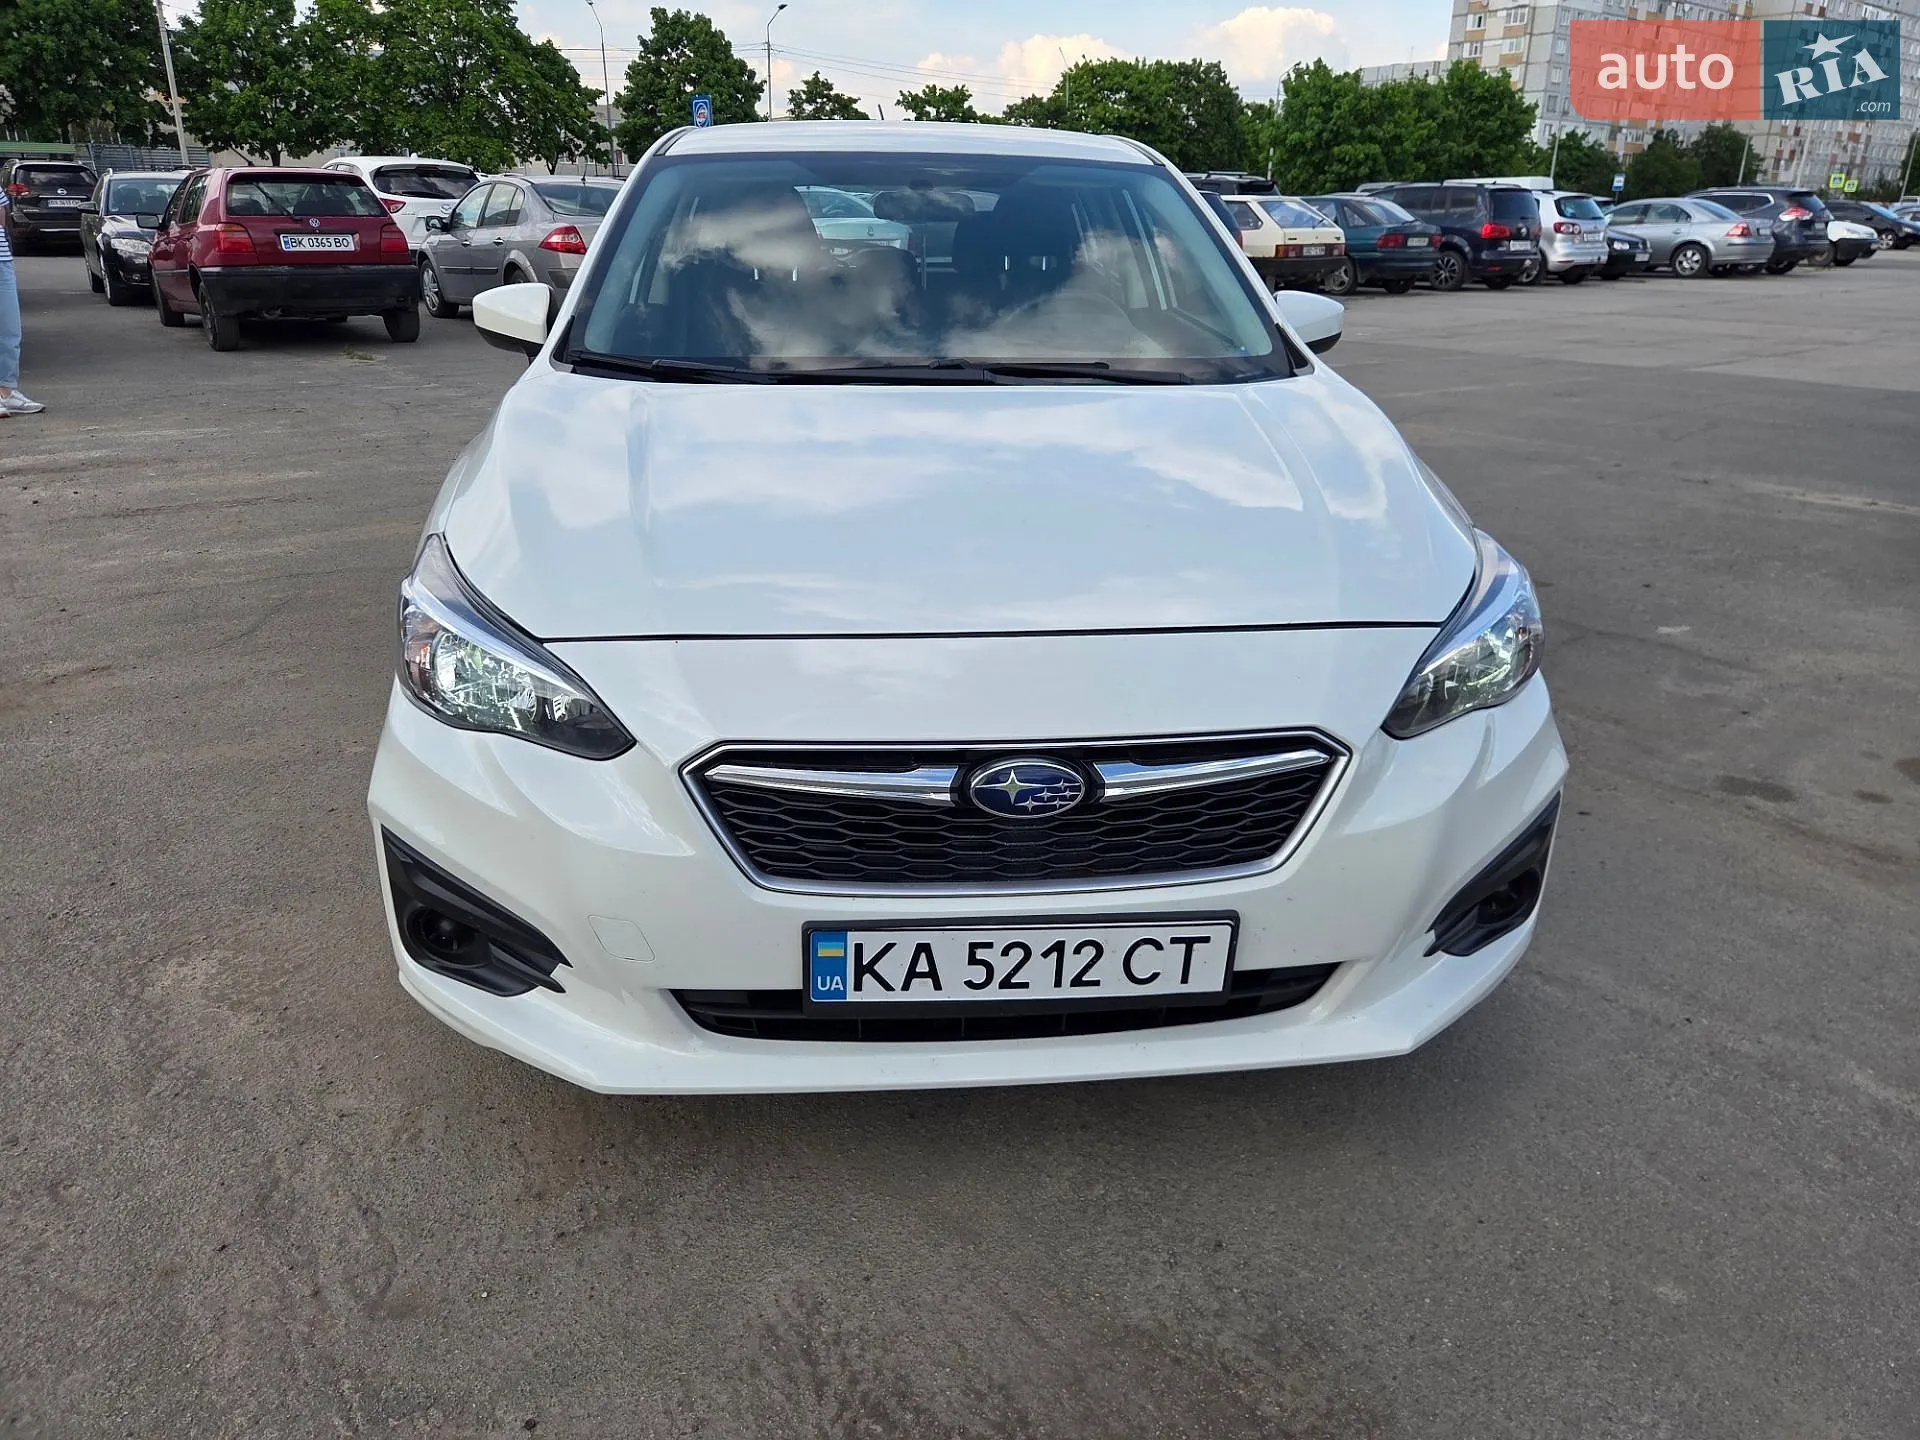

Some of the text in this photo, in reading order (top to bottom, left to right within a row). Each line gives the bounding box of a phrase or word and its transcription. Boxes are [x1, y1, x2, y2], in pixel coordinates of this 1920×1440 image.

[289, 237, 306, 248] BK
[307, 237, 333, 248] 0365
[333, 237, 350, 248] BO
[852, 935, 1212, 992] KA 5212 CT
[816, 975, 844, 991] UA
